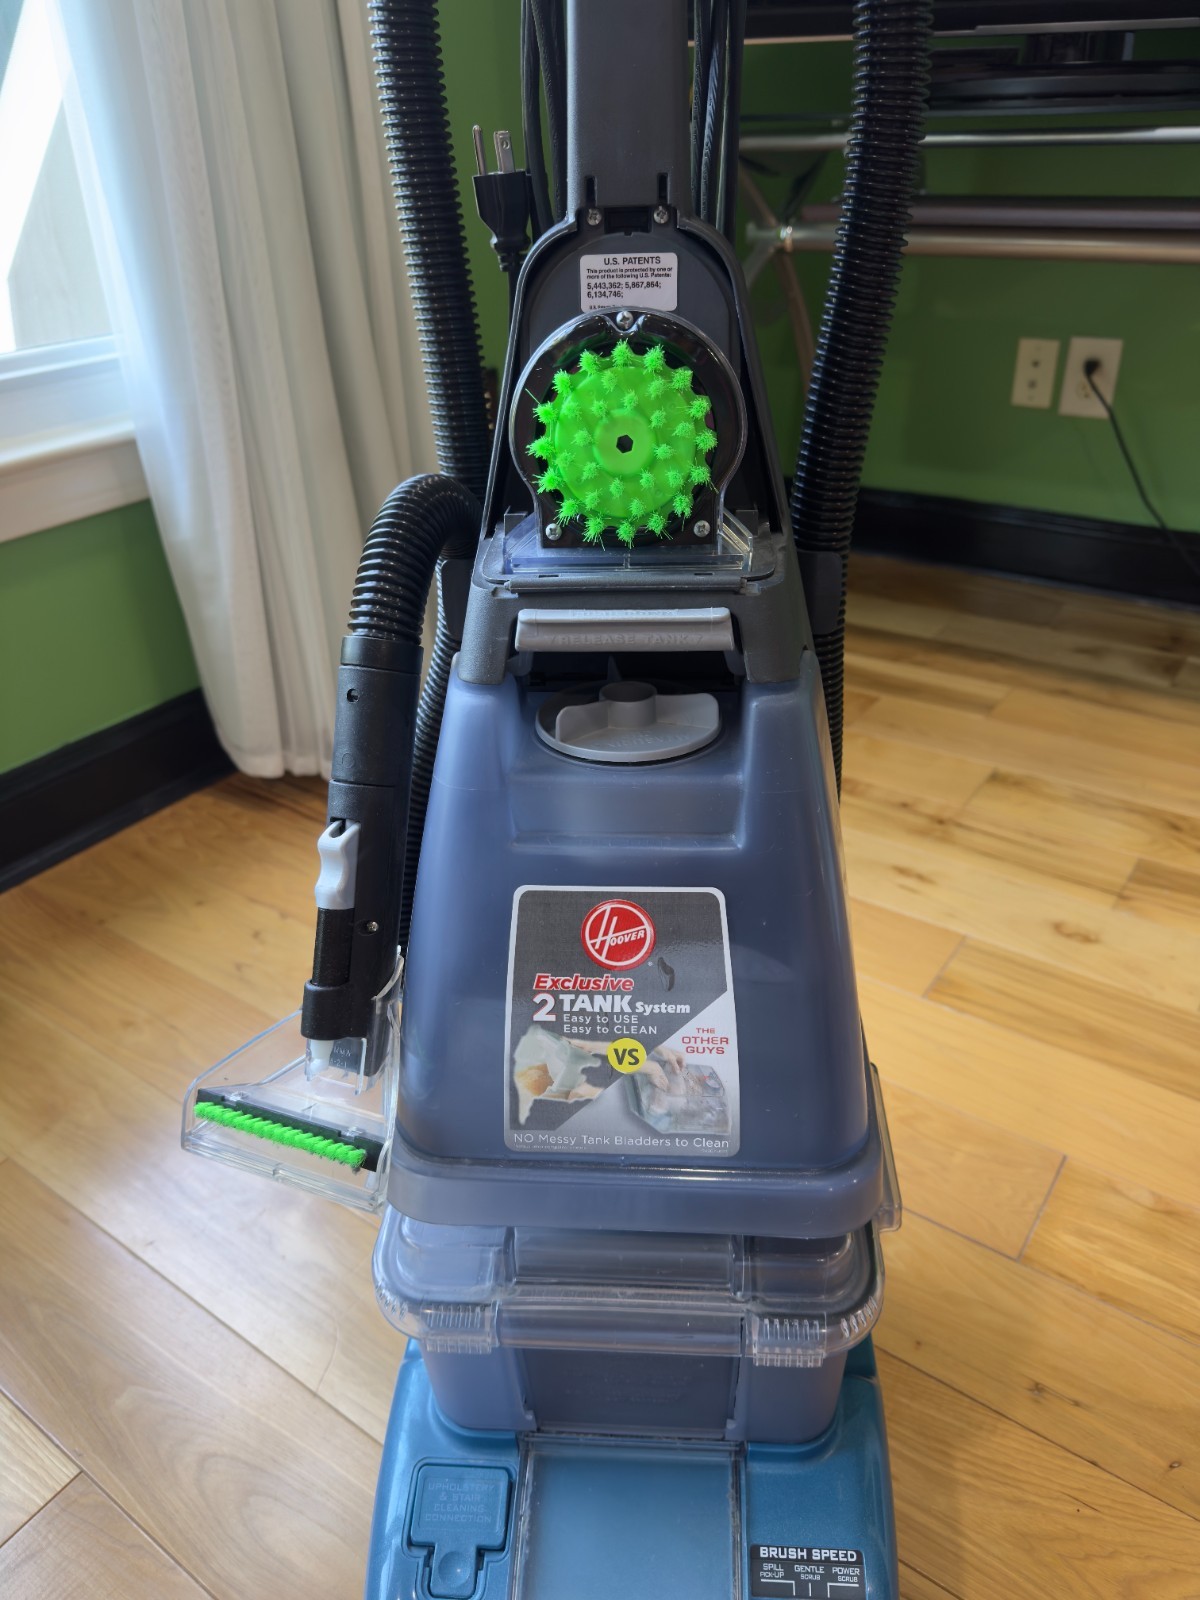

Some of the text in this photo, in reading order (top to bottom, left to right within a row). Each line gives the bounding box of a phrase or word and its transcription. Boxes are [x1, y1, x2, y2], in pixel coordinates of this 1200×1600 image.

[623, 256, 660, 264] PATENTS
[587, 291, 623, 299] 6,134,746;
[559, 634, 690, 645] RELEASE TANK
[533, 973, 634, 991] Exclusive
[533, 992, 690, 1021] 2 TANK System
[564, 1014, 638, 1025] Easy to USE
[564, 1025, 657, 1035] Easy to CLEAN
[682, 1037, 729, 1045] OTHER
[686, 1046, 725, 1054] GUYS
[614, 1049, 639, 1065] VS
[514, 1134, 729, 1148] NO Messy Tank Bladders to Clean
[428, 1483, 494, 1491] UPHOLSTERY
[440, 1492, 446, 1500] &
[434, 1504, 484, 1512] CLEANING
[425, 1514, 491, 1522] CONNECTION
[760, 1547, 856, 1561] BRUSH SPEED
[763, 1563, 784, 1571] SPILL
[794, 1565, 824, 1573] GENTLE
[832, 1567, 860, 1575] POWER
